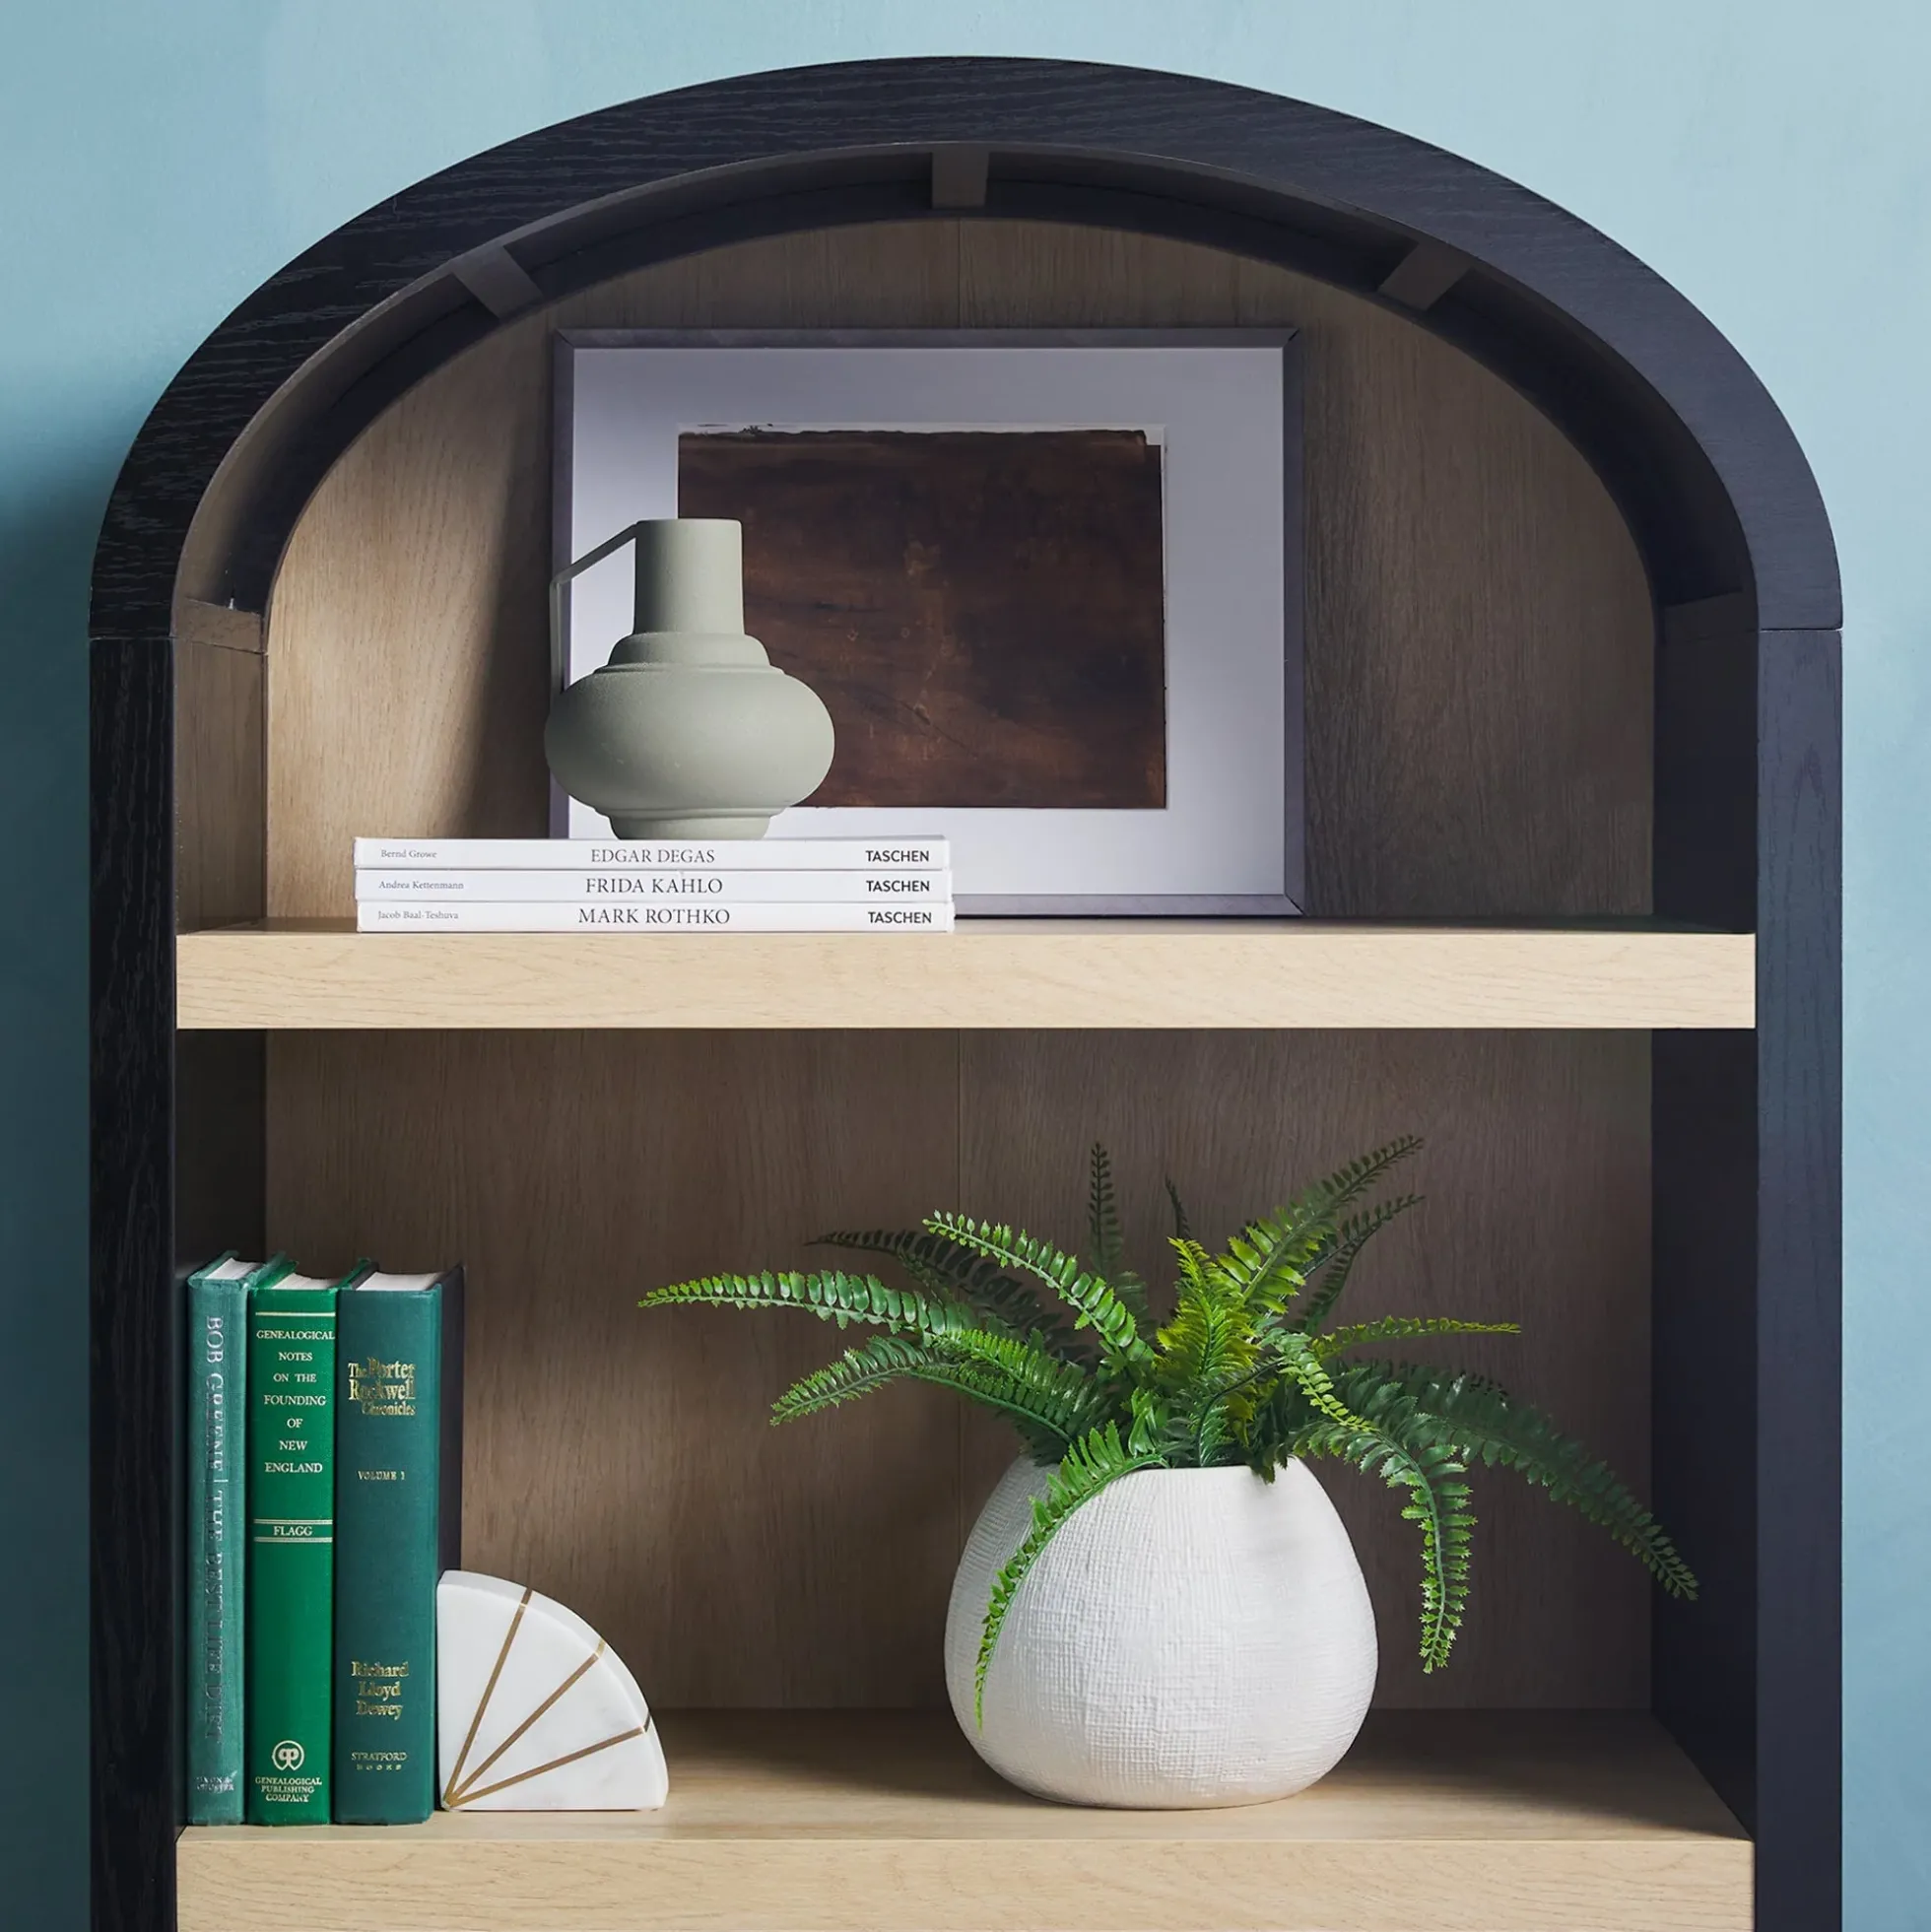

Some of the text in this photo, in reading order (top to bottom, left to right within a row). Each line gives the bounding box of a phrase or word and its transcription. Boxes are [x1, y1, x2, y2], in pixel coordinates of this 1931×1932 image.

[380, 849, 437, 858] Bernd Growe
[591, 848, 715, 863] EDGAR DEGAS
[865, 850, 930, 863] TASCHEN
[378, 880, 464, 890] Andrea Kettenmann
[585, 878, 723, 894] FRIDA KAHLO
[865, 880, 930, 893] TASCHEN
[377, 910, 459, 920] Jacob Baal-Teshuva
[578, 908, 730, 924] MARK ROTHKO
[868, 911, 932, 924] TASCHEN
[206, 1316, 224, 1363] BOB
[256, 1330, 335, 1341] GENEALOGICAL
[278, 1352, 313, 1363] NOTES
[348, 1358, 415, 1379] The Porter
[273, 1373, 317, 1384] ON THE
[348, 1379, 416, 1401] Rockwell
[263, 1395, 326, 1407] FOUNDING
[287, 1418, 302, 1429] OF
[279, 1440, 308, 1451] NEW
[264, 1462, 323, 1474] ENGLAND
[358, 1471, 397, 1481] VOLUME
[273, 1525, 312, 1537] FLAGG
[351, 1662, 409, 1678] Richard
[358, 1682, 401, 1700] Lloyd
[356, 1700, 403, 1720] Dewey
[351, 1752, 408, 1763] STRATFORD
[255, 1776, 322, 1787] GENEALOGICAL
[260, 1785, 315, 1795] PUBLISHING
[265, 1793, 309, 1804] COMPANY
